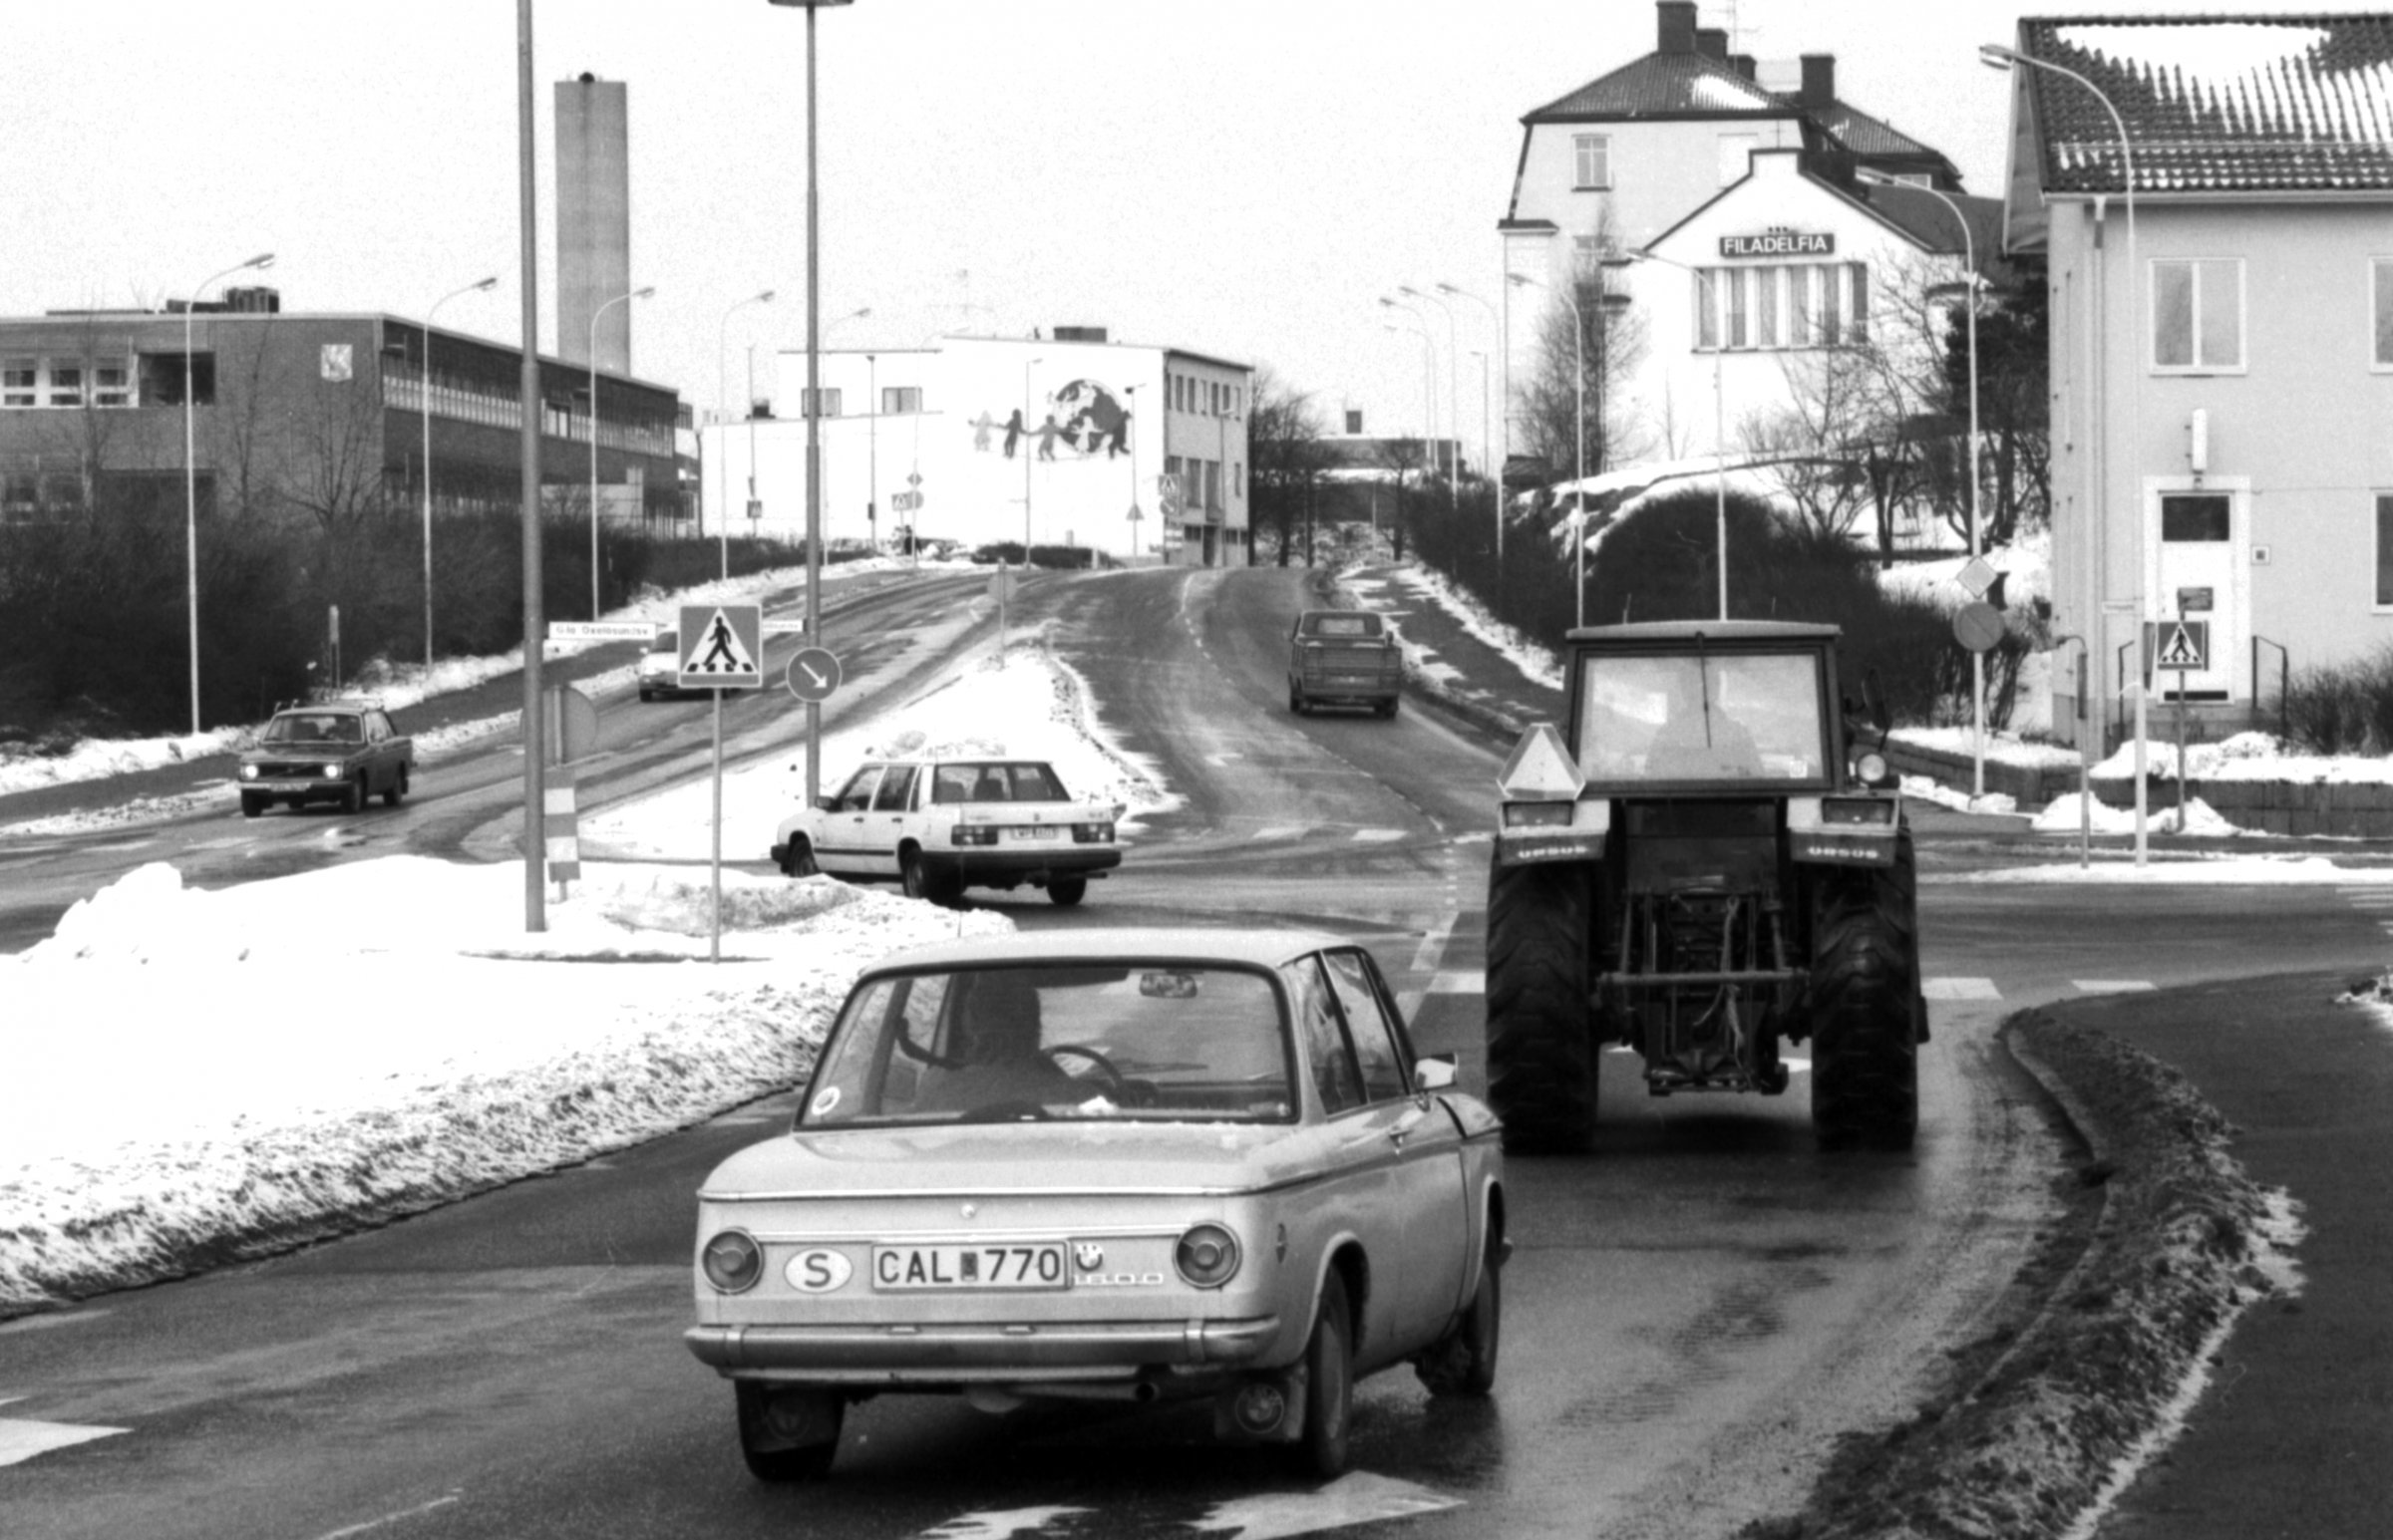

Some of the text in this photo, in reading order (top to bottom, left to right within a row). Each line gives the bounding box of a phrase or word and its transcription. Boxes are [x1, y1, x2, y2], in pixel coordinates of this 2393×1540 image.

[1723, 235, 1828, 254] FILADELFIA
[1518, 844, 1588, 858] URSUS
[1808, 846, 1880, 859] URSUS
[804, 1252, 832, 1288] S
[878, 1250, 953, 1284] CAL
[984, 1248, 1060, 1282] 770
